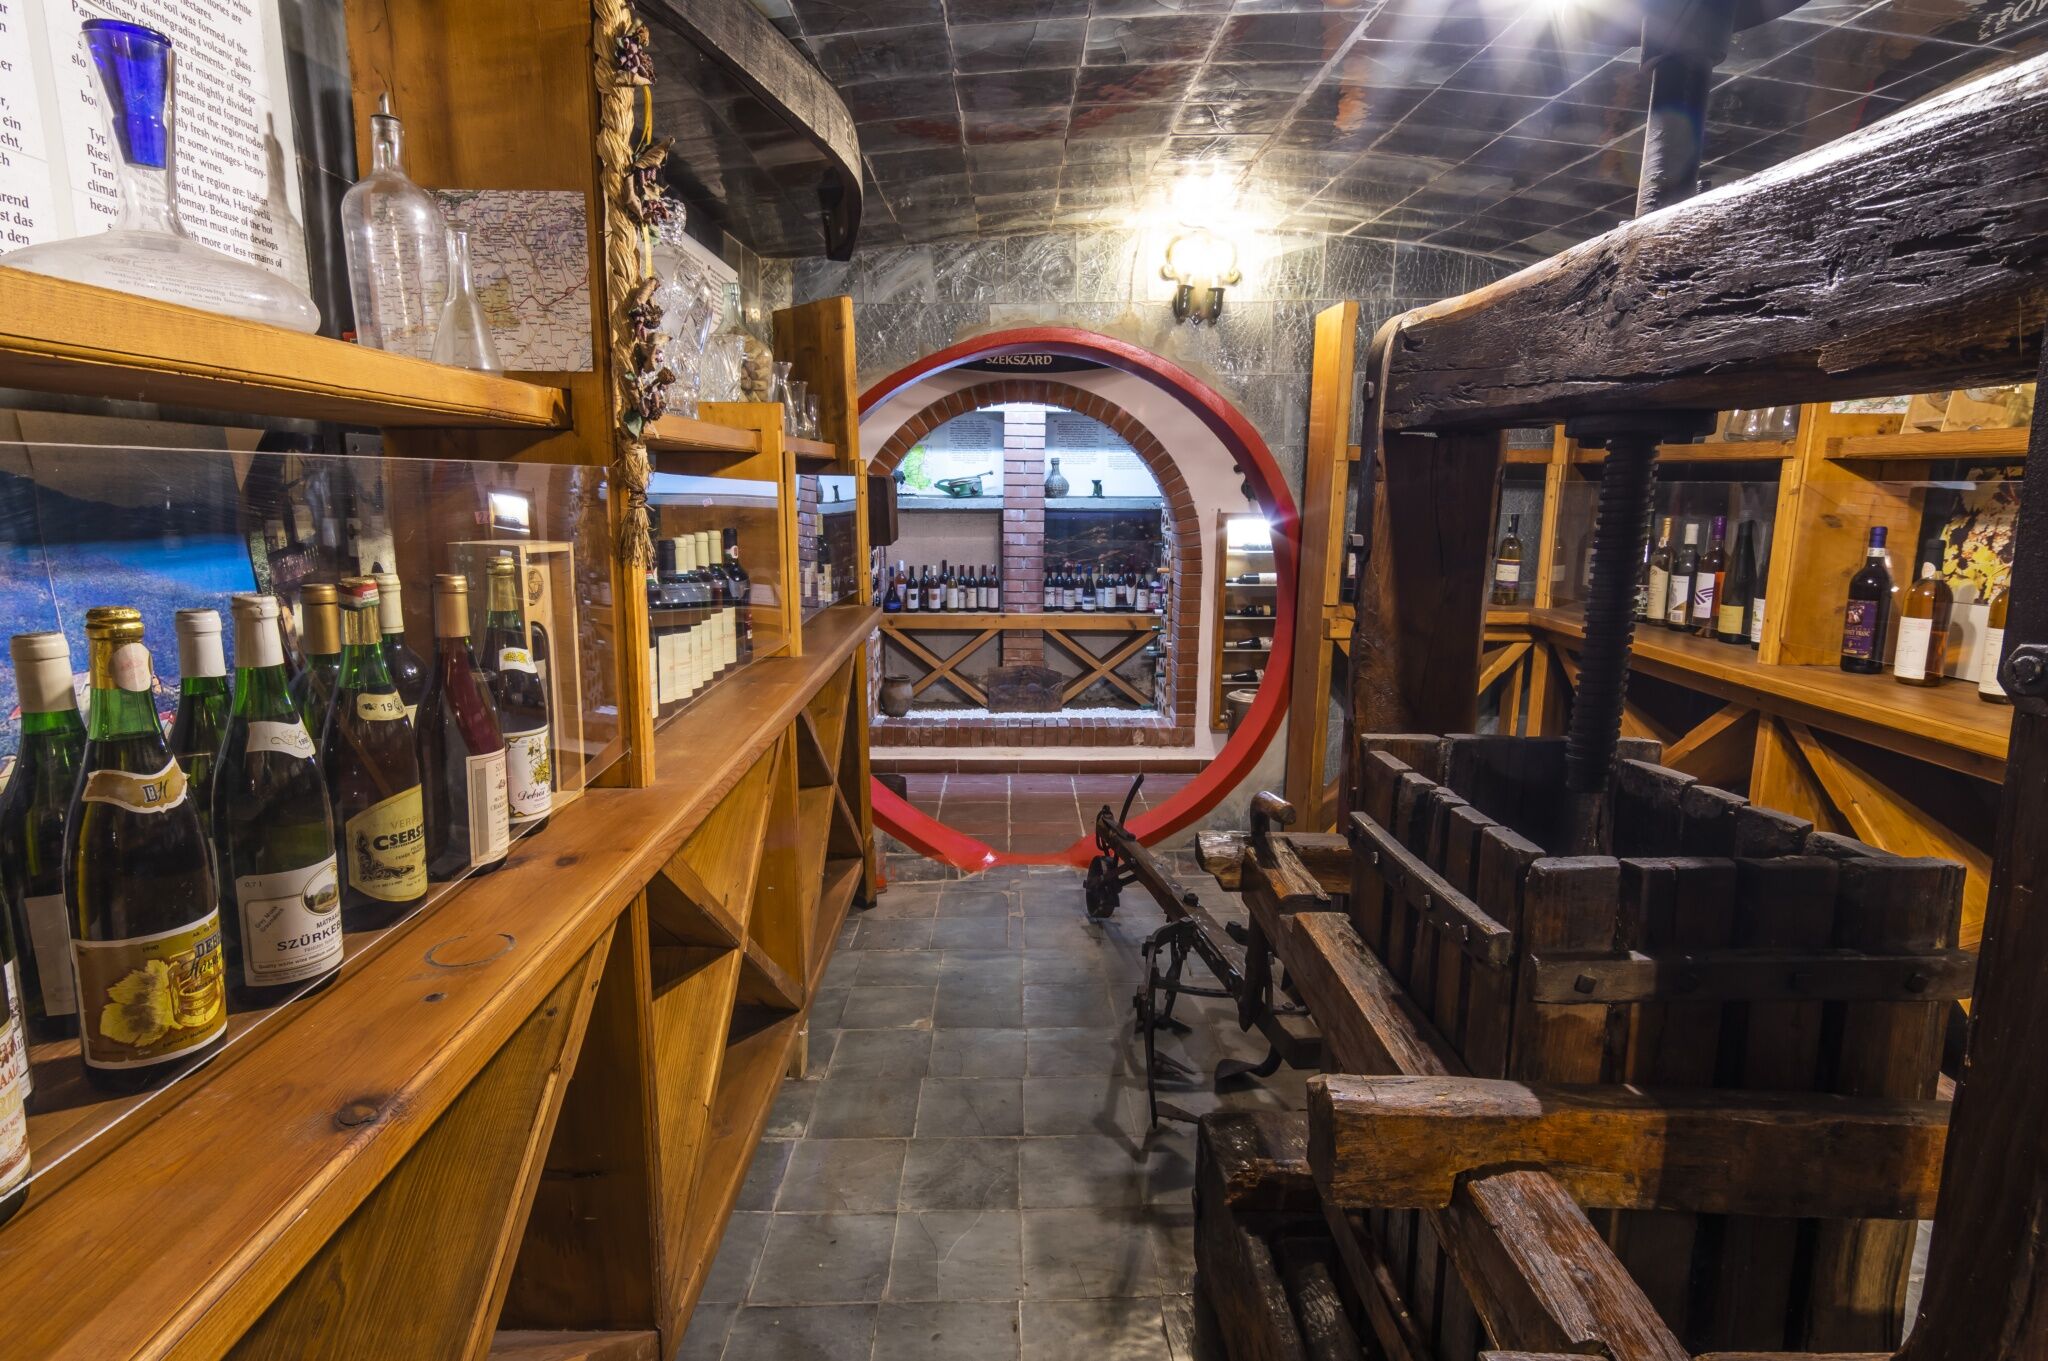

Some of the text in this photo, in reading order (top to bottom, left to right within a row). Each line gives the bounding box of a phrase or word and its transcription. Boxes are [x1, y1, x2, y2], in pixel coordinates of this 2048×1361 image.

[140, 2, 201, 47] disintegrading
[203, 39, 234, 62] volcanic
[163, 1, 249, 56] soil was formed of the
[182, 74, 253, 117] the slightly divided
[185, 61, 257, 105] of mixture of slope
[3, 116, 21, 131] ein
[176, 87, 259, 134] untains and forground
[181, 104, 196, 118] soil
[197, 112, 206, 123] of
[206, 115, 220, 128] the
[220, 123, 244, 142] region
[177, 131, 186, 144] in
[187, 137, 208, 152] some
[190, 121, 211, 140] fresh
[237, 143, 252, 158] rich
[252, 150, 260, 162] in
[181, 165, 190, 176] of
[192, 168, 205, 182] the
[206, 175, 231, 192] region
[13, 212, 34, 228] das
[209, 204, 240, 224] Because
[240, 217, 249, 227] of
[249, 219, 261, 231] the
[261, 224, 273, 235] hot
[7, 229, 30, 245] den
[201, 235, 222, 249] more
[223, 244, 232, 252] or
[232, 243, 247, 257] less
[247, 251, 275, 266] remains
[209, 221, 229, 234] must
[229, 227, 249, 241] often
[250, 233, 279, 251] develops
